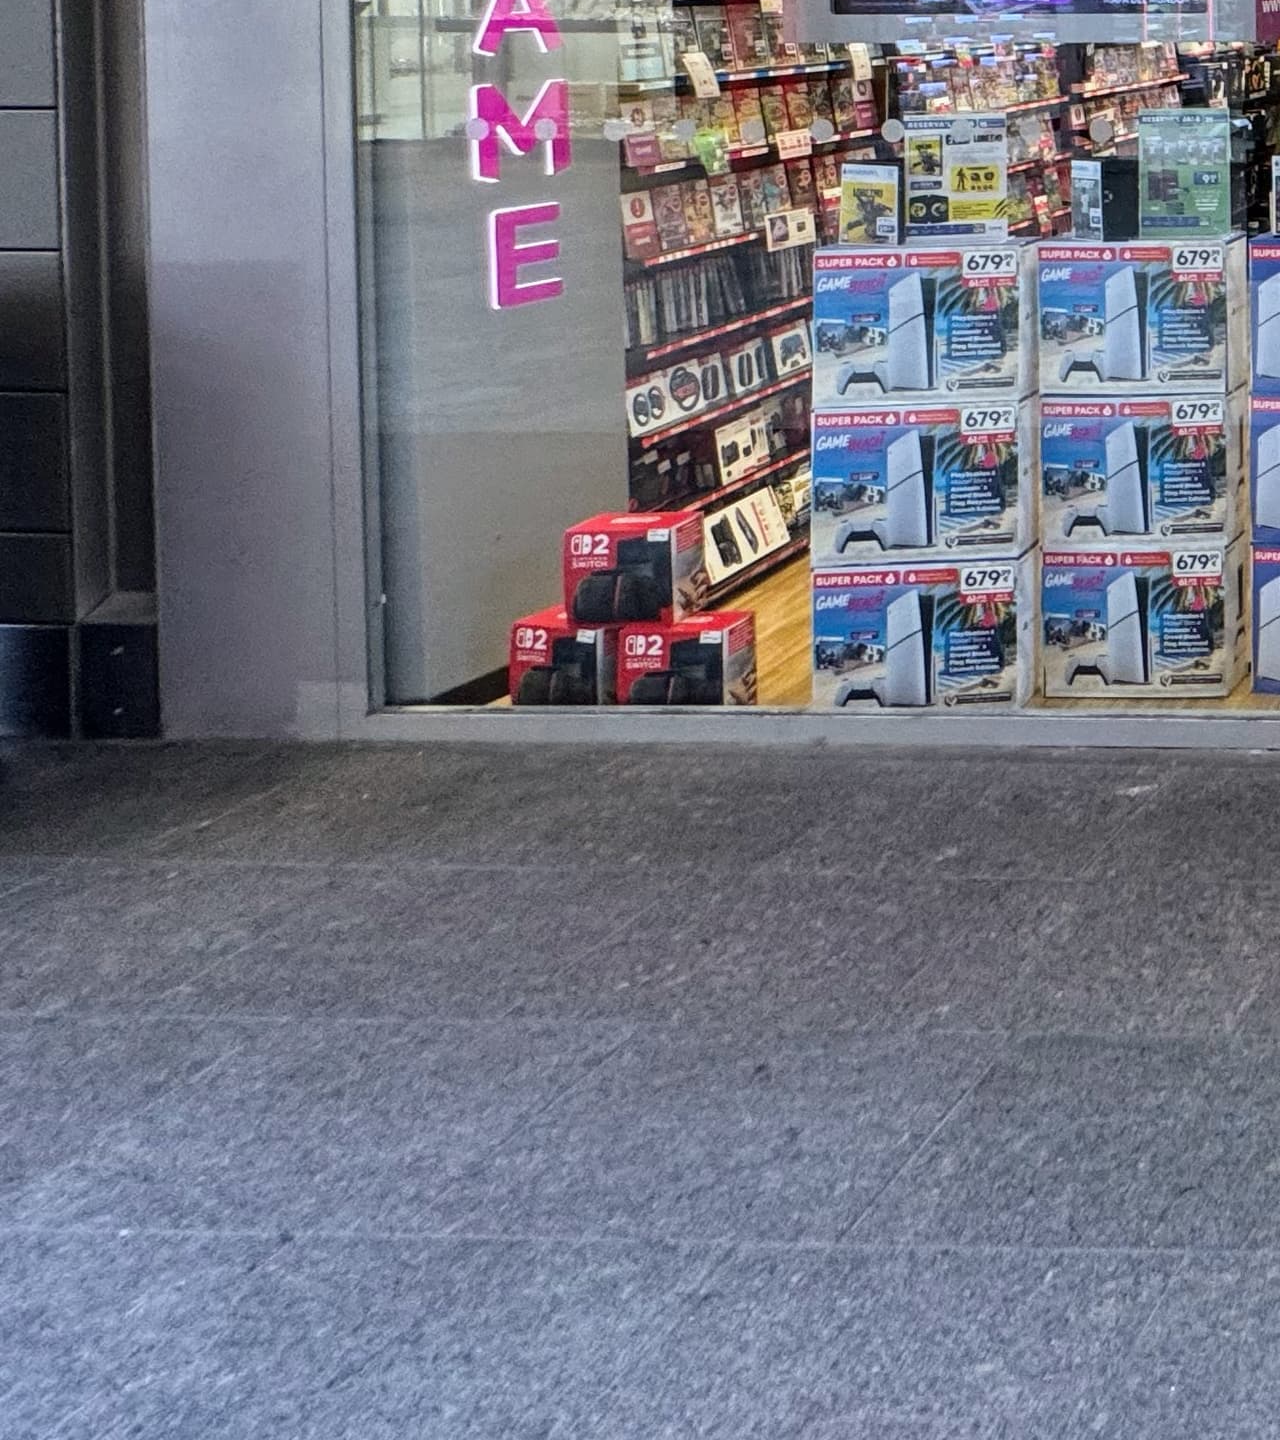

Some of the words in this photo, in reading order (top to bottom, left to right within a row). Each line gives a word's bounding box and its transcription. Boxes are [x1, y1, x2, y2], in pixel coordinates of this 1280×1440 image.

[1040, 250, 1072, 259] SUPER
[1074, 250, 1100, 259] PACK
[1253, 248, 1280, 257] SUPER
[817, 257, 852, 268] SUPER
[855, 256, 884, 266] PACK
[1043, 406, 1073, 415] SUPER
[1074, 406, 1100, 415] PACK
[817, 415, 851, 426] SUPER
[854, 415, 883, 425] PACK
[1045, 555, 1075, 564] SUPER
[1077, 555, 1102, 564] PACK
[816, 575, 851, 586] SUPER
[853, 575, 882, 585] PACK
